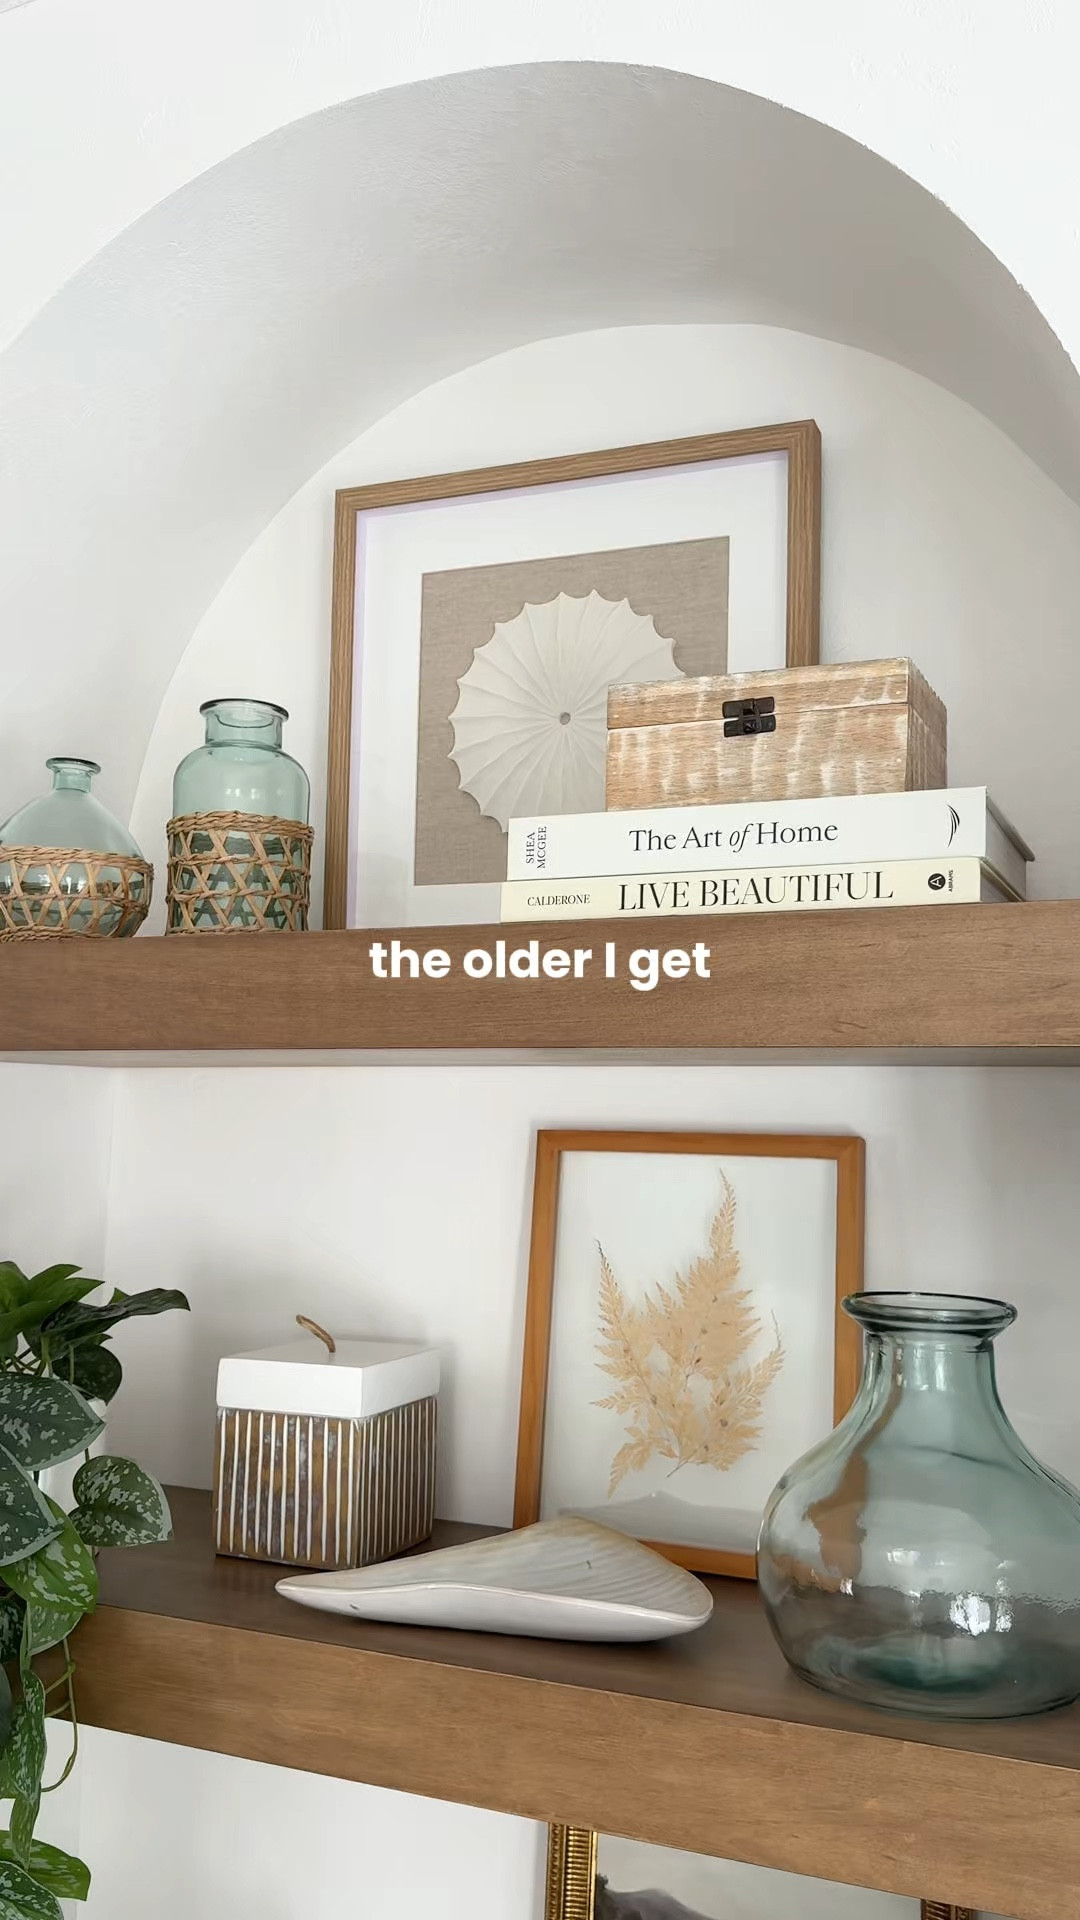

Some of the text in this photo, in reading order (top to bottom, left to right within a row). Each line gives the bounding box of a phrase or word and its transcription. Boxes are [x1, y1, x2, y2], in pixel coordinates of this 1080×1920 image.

[525, 831, 535, 864] SHEA
[536, 826, 547, 869] MCGEE
[629, 821, 838, 853] The Art of Home
[527, 894, 592, 907] CALDERONE
[618, 871, 894, 911] LIVE BEAUTIFUL
